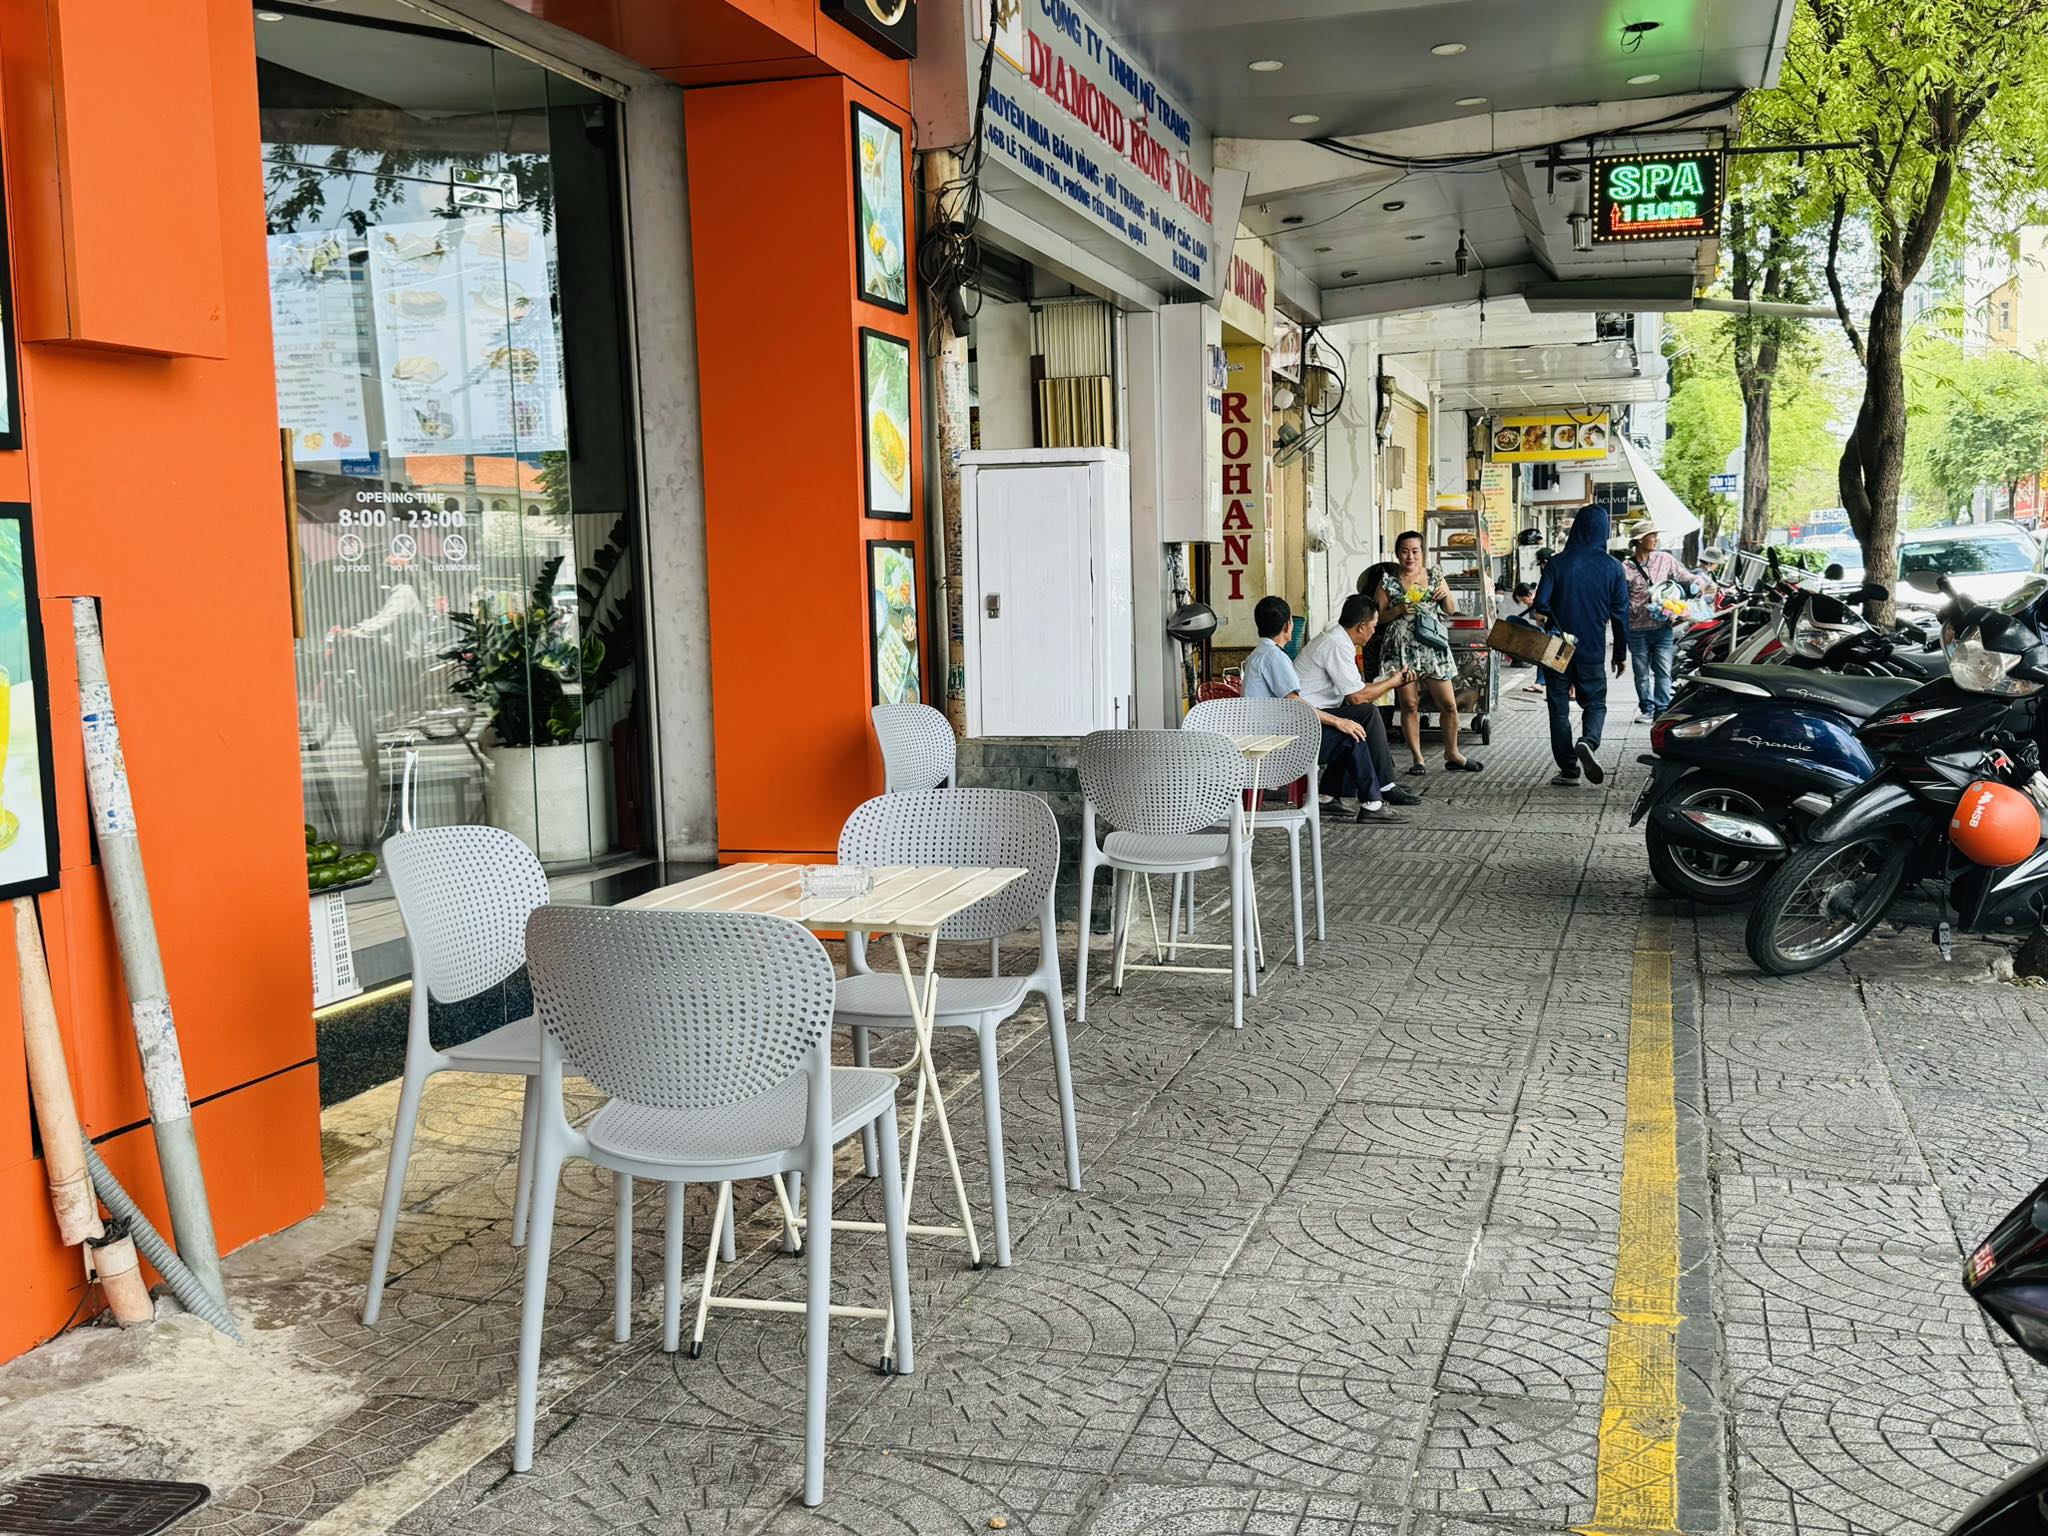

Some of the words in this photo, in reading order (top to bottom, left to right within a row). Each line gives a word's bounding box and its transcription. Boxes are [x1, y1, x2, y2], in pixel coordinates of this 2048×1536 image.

[1085, 24, 1103, 64] TY
[1106, 46, 1138, 99] TNHH
[1156, 94, 1191, 147] TRANG
[1028, 28, 1125, 153] DIAMOND
[1175, 150, 1212, 224] VÀNG
[1007, 134, 1018, 159] LÊ
[1019, 146, 1045, 178] THÁNH
[987, 85, 1025, 135] HUYÊN
[1027, 114, 1050, 152] MUA
[1052, 134, 1073, 168] BÁN
[1075, 147, 1100, 187] VÀNG
[1119, 183, 1146, 221] TRANG
[1178, 226, 1192, 252] CÁC
[1609, 162, 1704, 200] SPA
[1622, 205, 1632, 222] 1
[1637, 201, 1697, 221] FLOOR
[1234, 254, 1267, 315] DATANG
[356, 491, 414, 504] OPENING
[417, 492, 445, 504] TIME
[1222, 391, 1253, 600] ROHANI
[338, 509, 386, 528] 8:00
[408, 510, 465, 528] 23:00
[333, 564, 346, 573] NO
[347, 564, 371, 572] FOOD
[391, 563, 402, 572] NO
[404, 563, 420, 572] PET
[432, 564, 444, 572] NO
[1740, 735, 1814, 752] Grande
[1969, 804, 1985, 828] MSB
